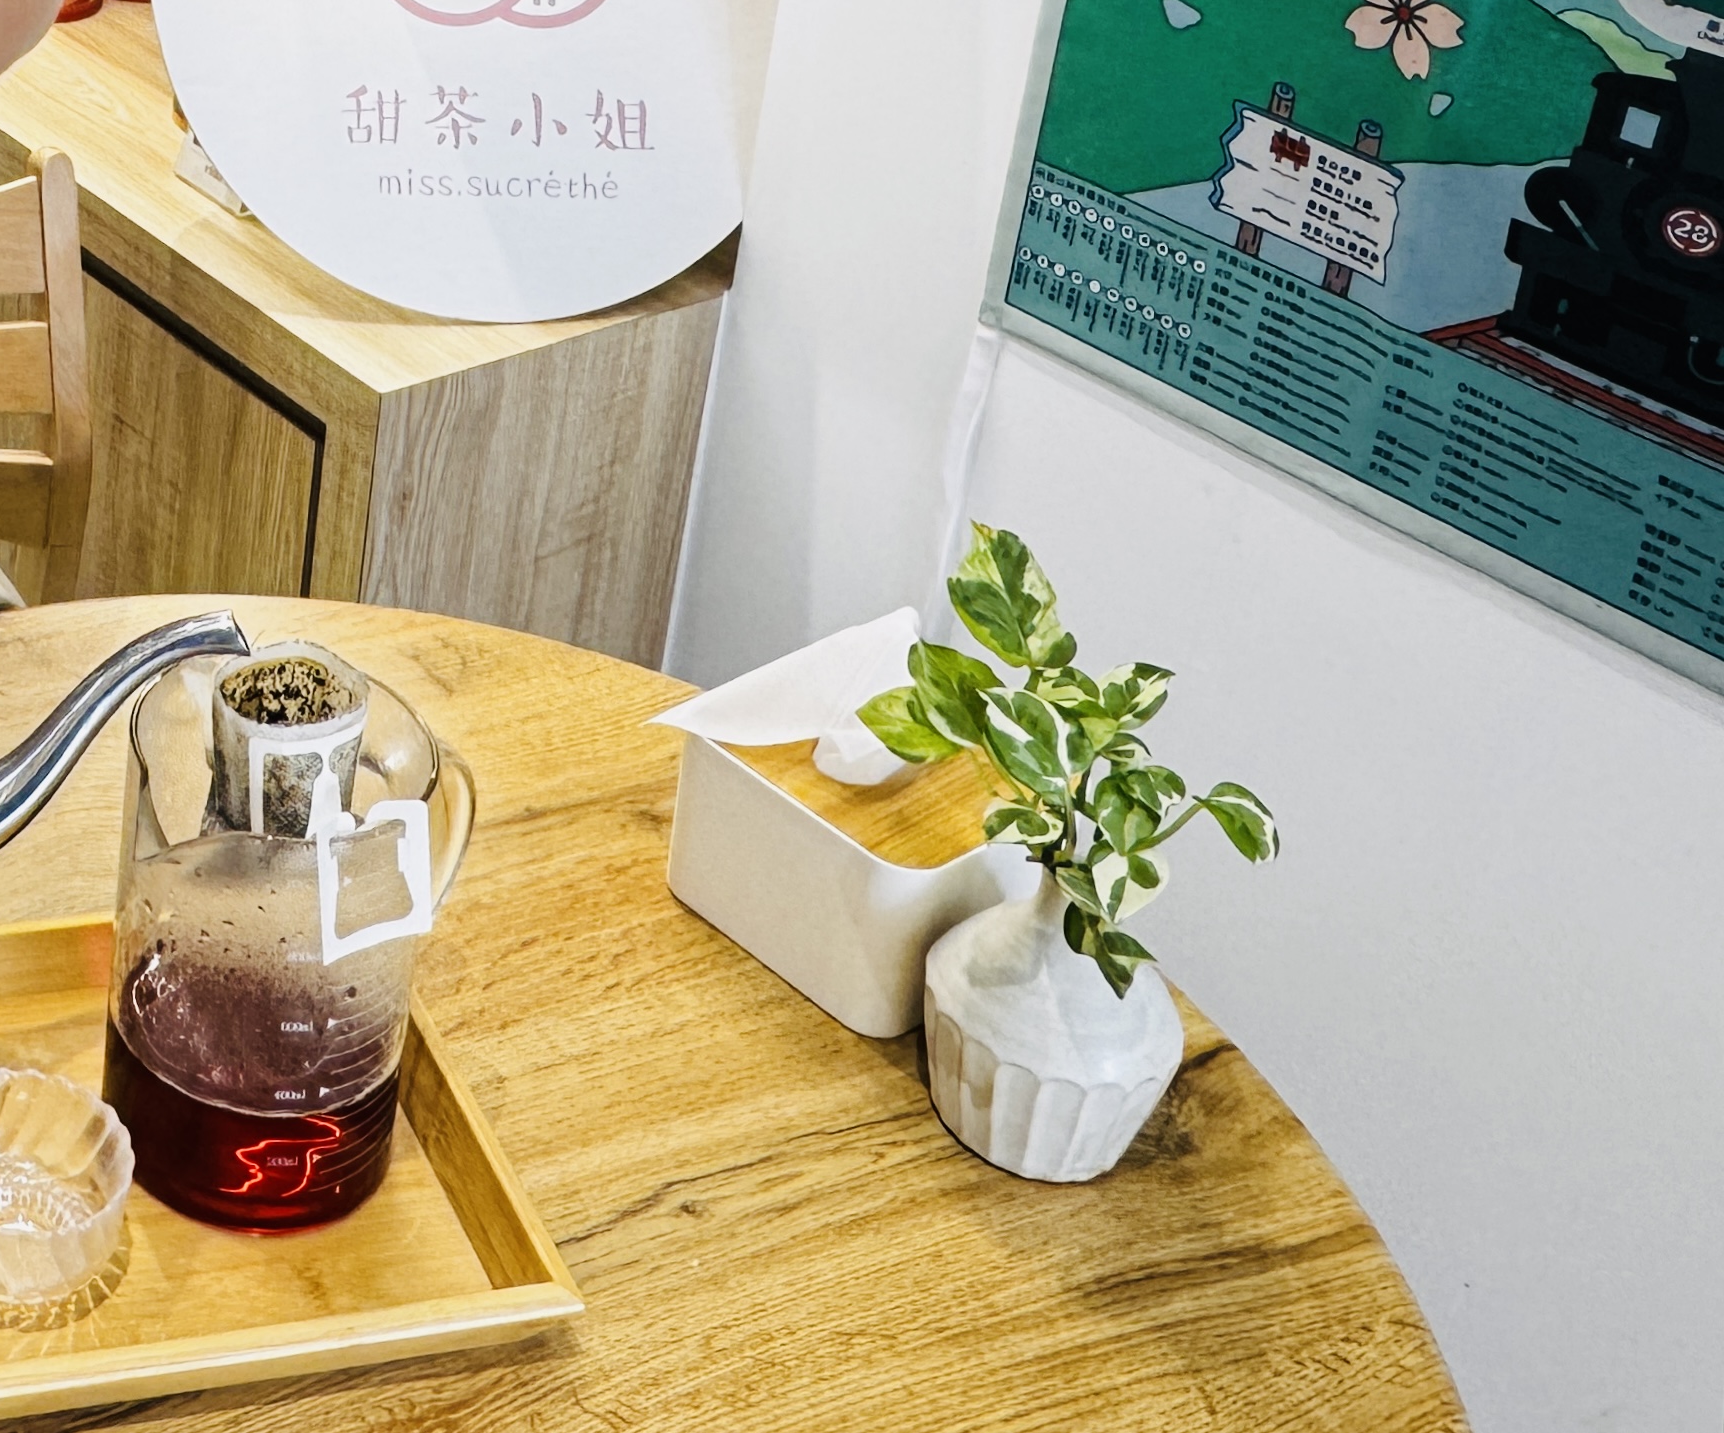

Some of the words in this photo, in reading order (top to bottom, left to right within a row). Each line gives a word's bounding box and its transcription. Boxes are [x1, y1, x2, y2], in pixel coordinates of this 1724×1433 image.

[341, 85, 655, 151] 甜茶小姐
[379, 169, 619, 200] miss.sucréthé
[1674, 218, 1709, 244] 28
